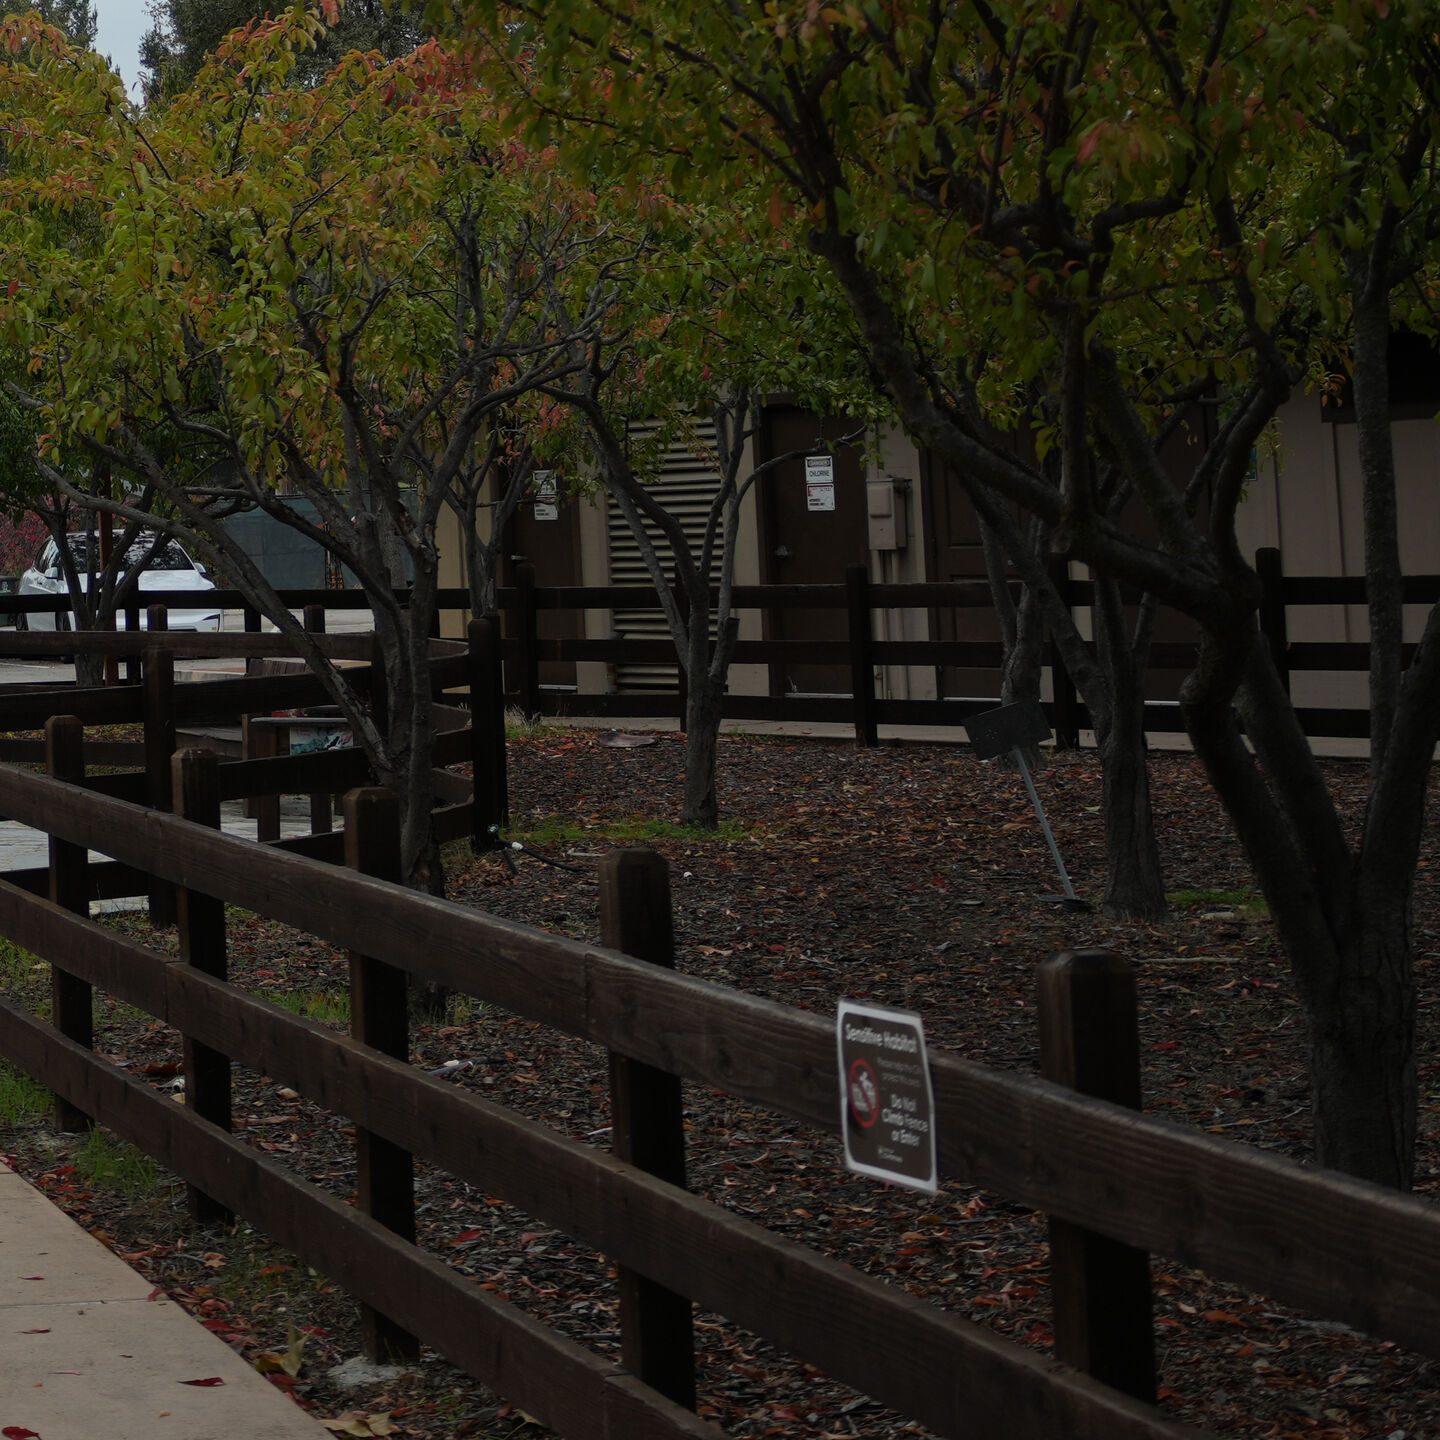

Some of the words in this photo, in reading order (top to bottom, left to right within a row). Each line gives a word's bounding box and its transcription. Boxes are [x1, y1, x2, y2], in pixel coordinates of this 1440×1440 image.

[846, 1024, 883, 1047] Sensitive
[884, 1031, 918, 1054] Habitat
[891, 1094, 902, 1109] Do
[903, 1096, 917, 1113] Not
[882, 1108, 904, 1127] Climb
[905, 1114, 929, 1133] Fence
[891, 1130, 900, 1142] or
[901, 1129, 920, 1147] Enter
